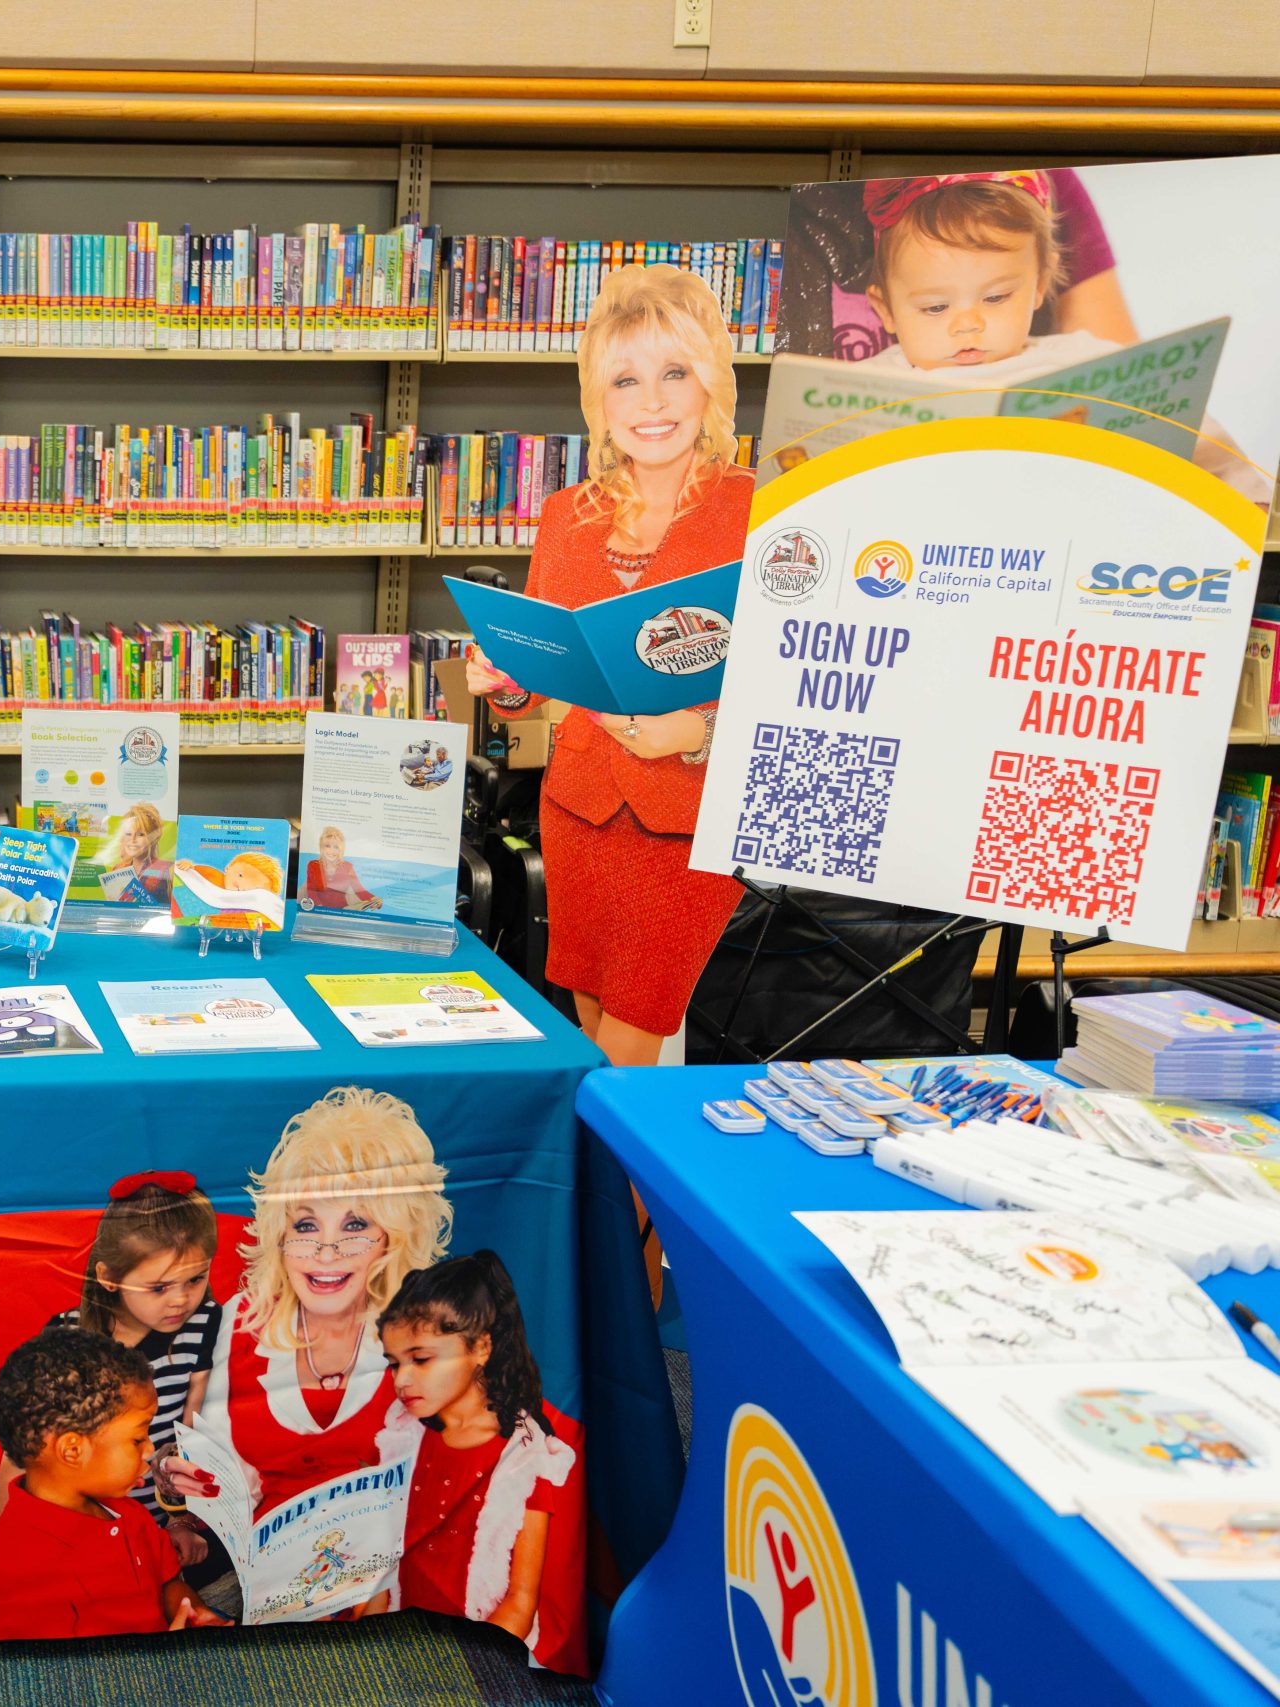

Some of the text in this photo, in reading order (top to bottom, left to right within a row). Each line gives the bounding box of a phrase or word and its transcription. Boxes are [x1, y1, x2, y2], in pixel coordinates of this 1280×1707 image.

[272, 281, 284, 306] PAPE
[453, 272, 462, 304] HUNGRY
[1012, 334, 1216, 415] CORDUROY
[1106, 364, 1199, 402] GOES TO
[1131, 388, 1170, 410] THE
[1103, 396, 1195, 432] DOCTOR
[282, 464, 291, 481] SOUL
[396, 449, 406, 476] LIZARD
[922, 543, 1046, 572] UNITED WAY
[762, 569, 819, 585] IMAGINATION
[770, 581, 806, 594] LIBRARY
[919, 570, 1052, 593] California Capital
[1088, 562, 1232, 603] SCOE
[759, 588, 815, 607] Sacramento County
[916, 587, 970, 605] Region
[1079, 596, 1232, 615] Sacramento County Office of Education
[1112, 609, 1193, 622] EDUCATION EMPOWERS
[487, 623, 511, 635] Dream
[510, 629, 530, 641] More,
[345, 642, 402, 654] OUTSIDER
[647, 636, 731, 670] IMAGINATION
[656, 635, 719, 659] Dolly Parton's
[779, 619, 910, 669] SIGN UP
[352, 653, 395, 667] KIDS
[666, 651, 722, 676] LIBRARY
[988, 628, 1206, 697] REGÍSTRATE
[797, 668, 876, 714] NOW
[1019, 690, 1145, 745] AHORA
[31, 732, 99, 742] Book Selection
[315, 728, 359, 738] Logic Model
[312, 785, 396, 800] Imagination Library Strives
[2, 837, 25, 850] Sleep
[0, 847, 44, 863] Polar Bear
[16, 874, 38, 887] Polar
[151, 983, 224, 992] Research
[326, 976, 375, 984] Books
[395, 975, 470, 984] Selection
[257, 1461, 409, 1549] DOLLY PARTON
[266, 1499, 396, 1557] COAT MANY COLORS
